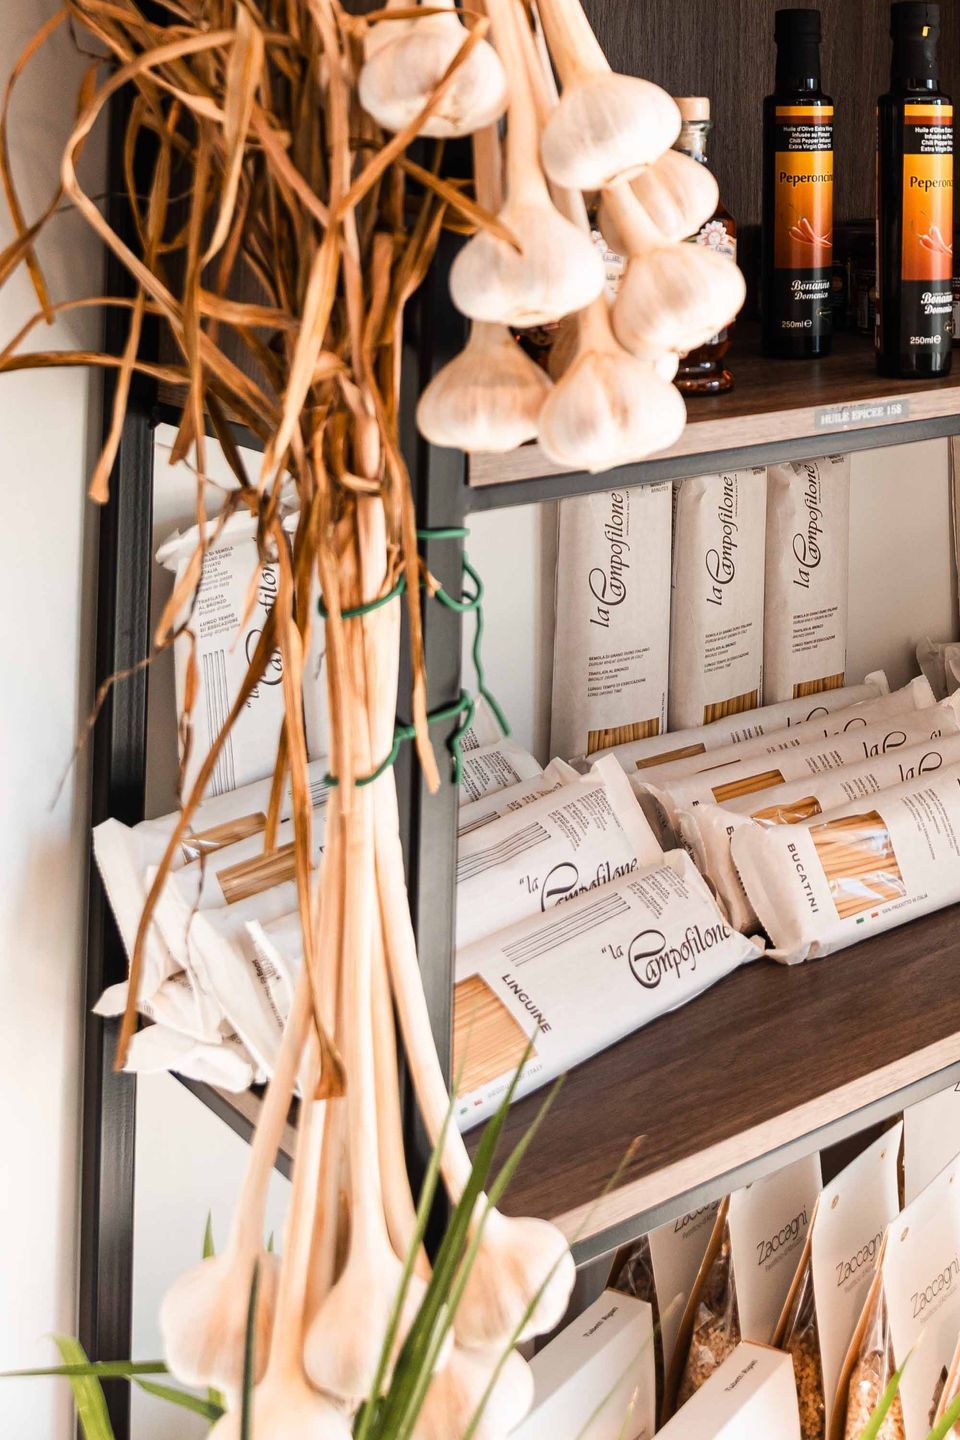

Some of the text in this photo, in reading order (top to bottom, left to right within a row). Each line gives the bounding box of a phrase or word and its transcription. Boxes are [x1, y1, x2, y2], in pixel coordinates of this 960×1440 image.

[782, 320, 804, 328] 250ml
[794, 291, 828, 300] Domenico
[910, 336, 934, 344] 250ml
[821, 412, 849, 424] HUILE
[706, 476, 738, 605] la Campofilone
[793, 462, 823, 588] la Campofilone
[589, 492, 630, 628] la Campofilone
[787, 843, 819, 913] BUCATINI
[502, 973, 551, 1034] LINGUINE
[757, 1205, 808, 1266] Zaccagni
[836, 1226, 883, 1287] Zaccagni
[910, 1253, 960, 1319] Zaccagni
